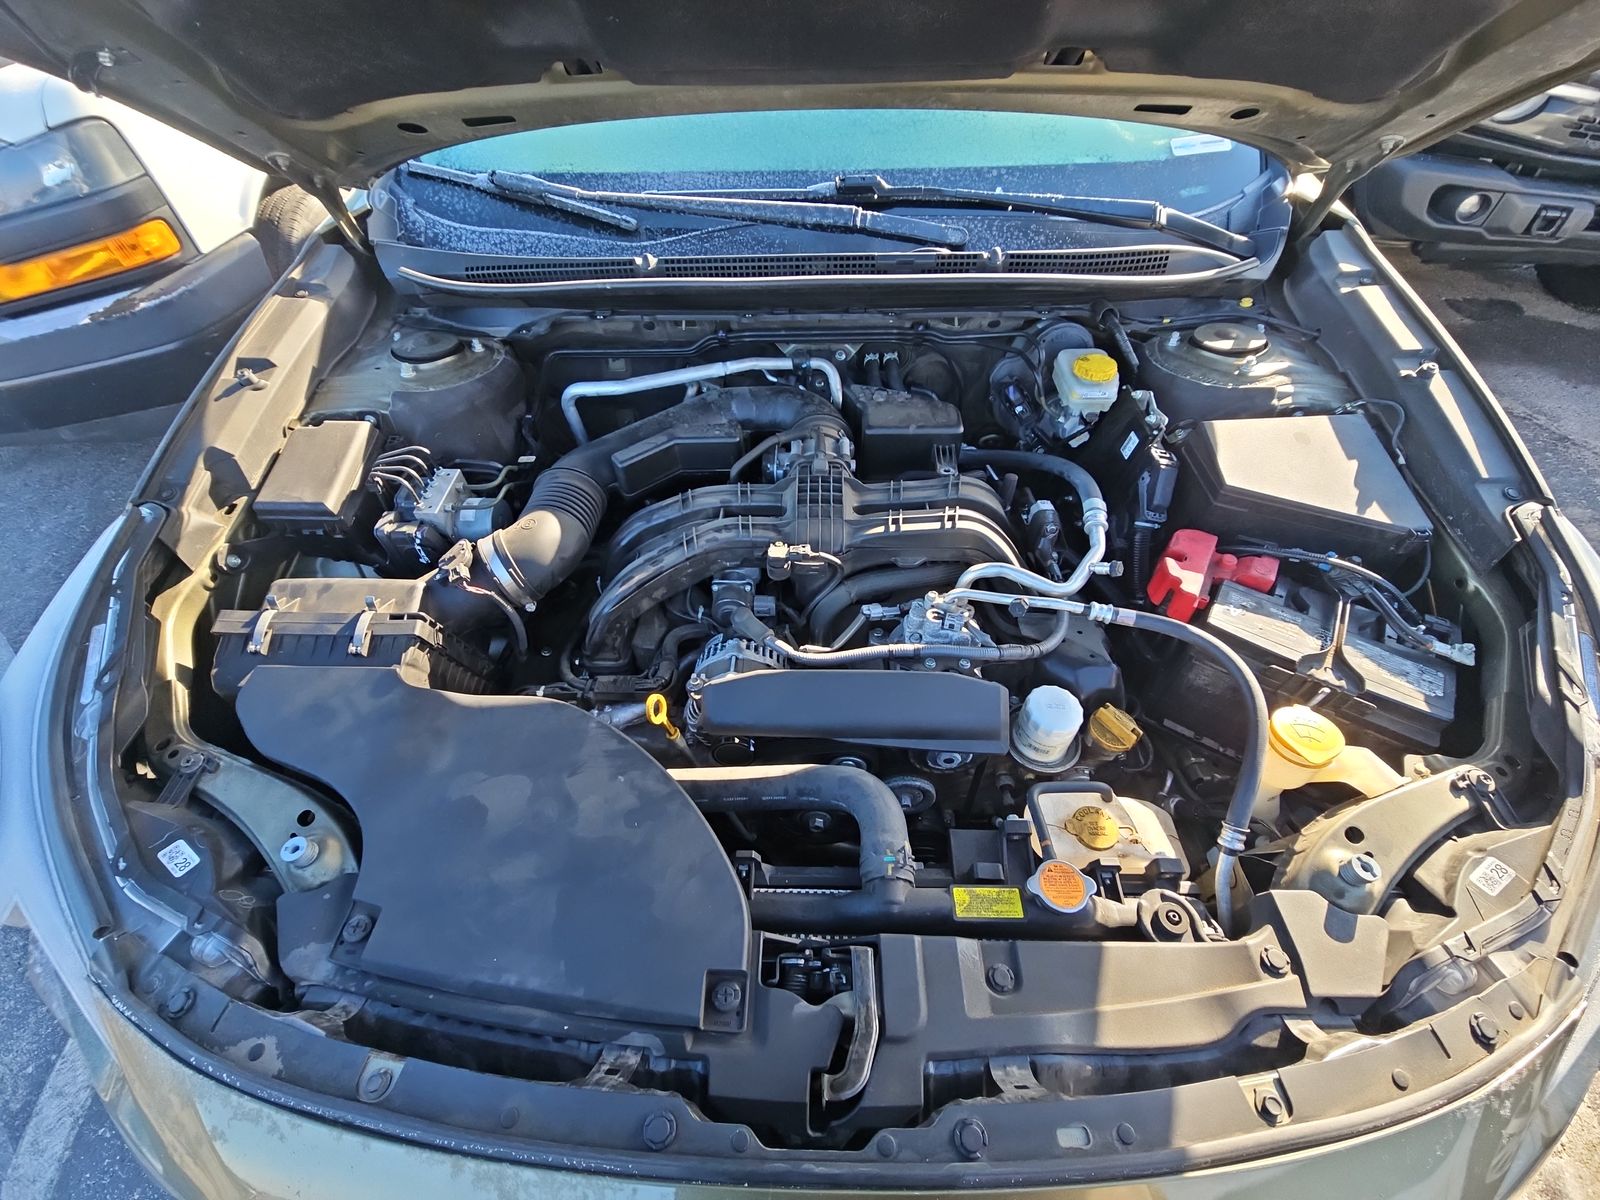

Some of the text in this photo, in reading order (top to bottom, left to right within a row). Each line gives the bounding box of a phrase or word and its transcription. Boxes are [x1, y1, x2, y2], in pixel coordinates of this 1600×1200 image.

[1075, 808, 1112, 821] COOLANT
[174, 858, 191, 871] 28
[1490, 863, 1508, 879] 28
